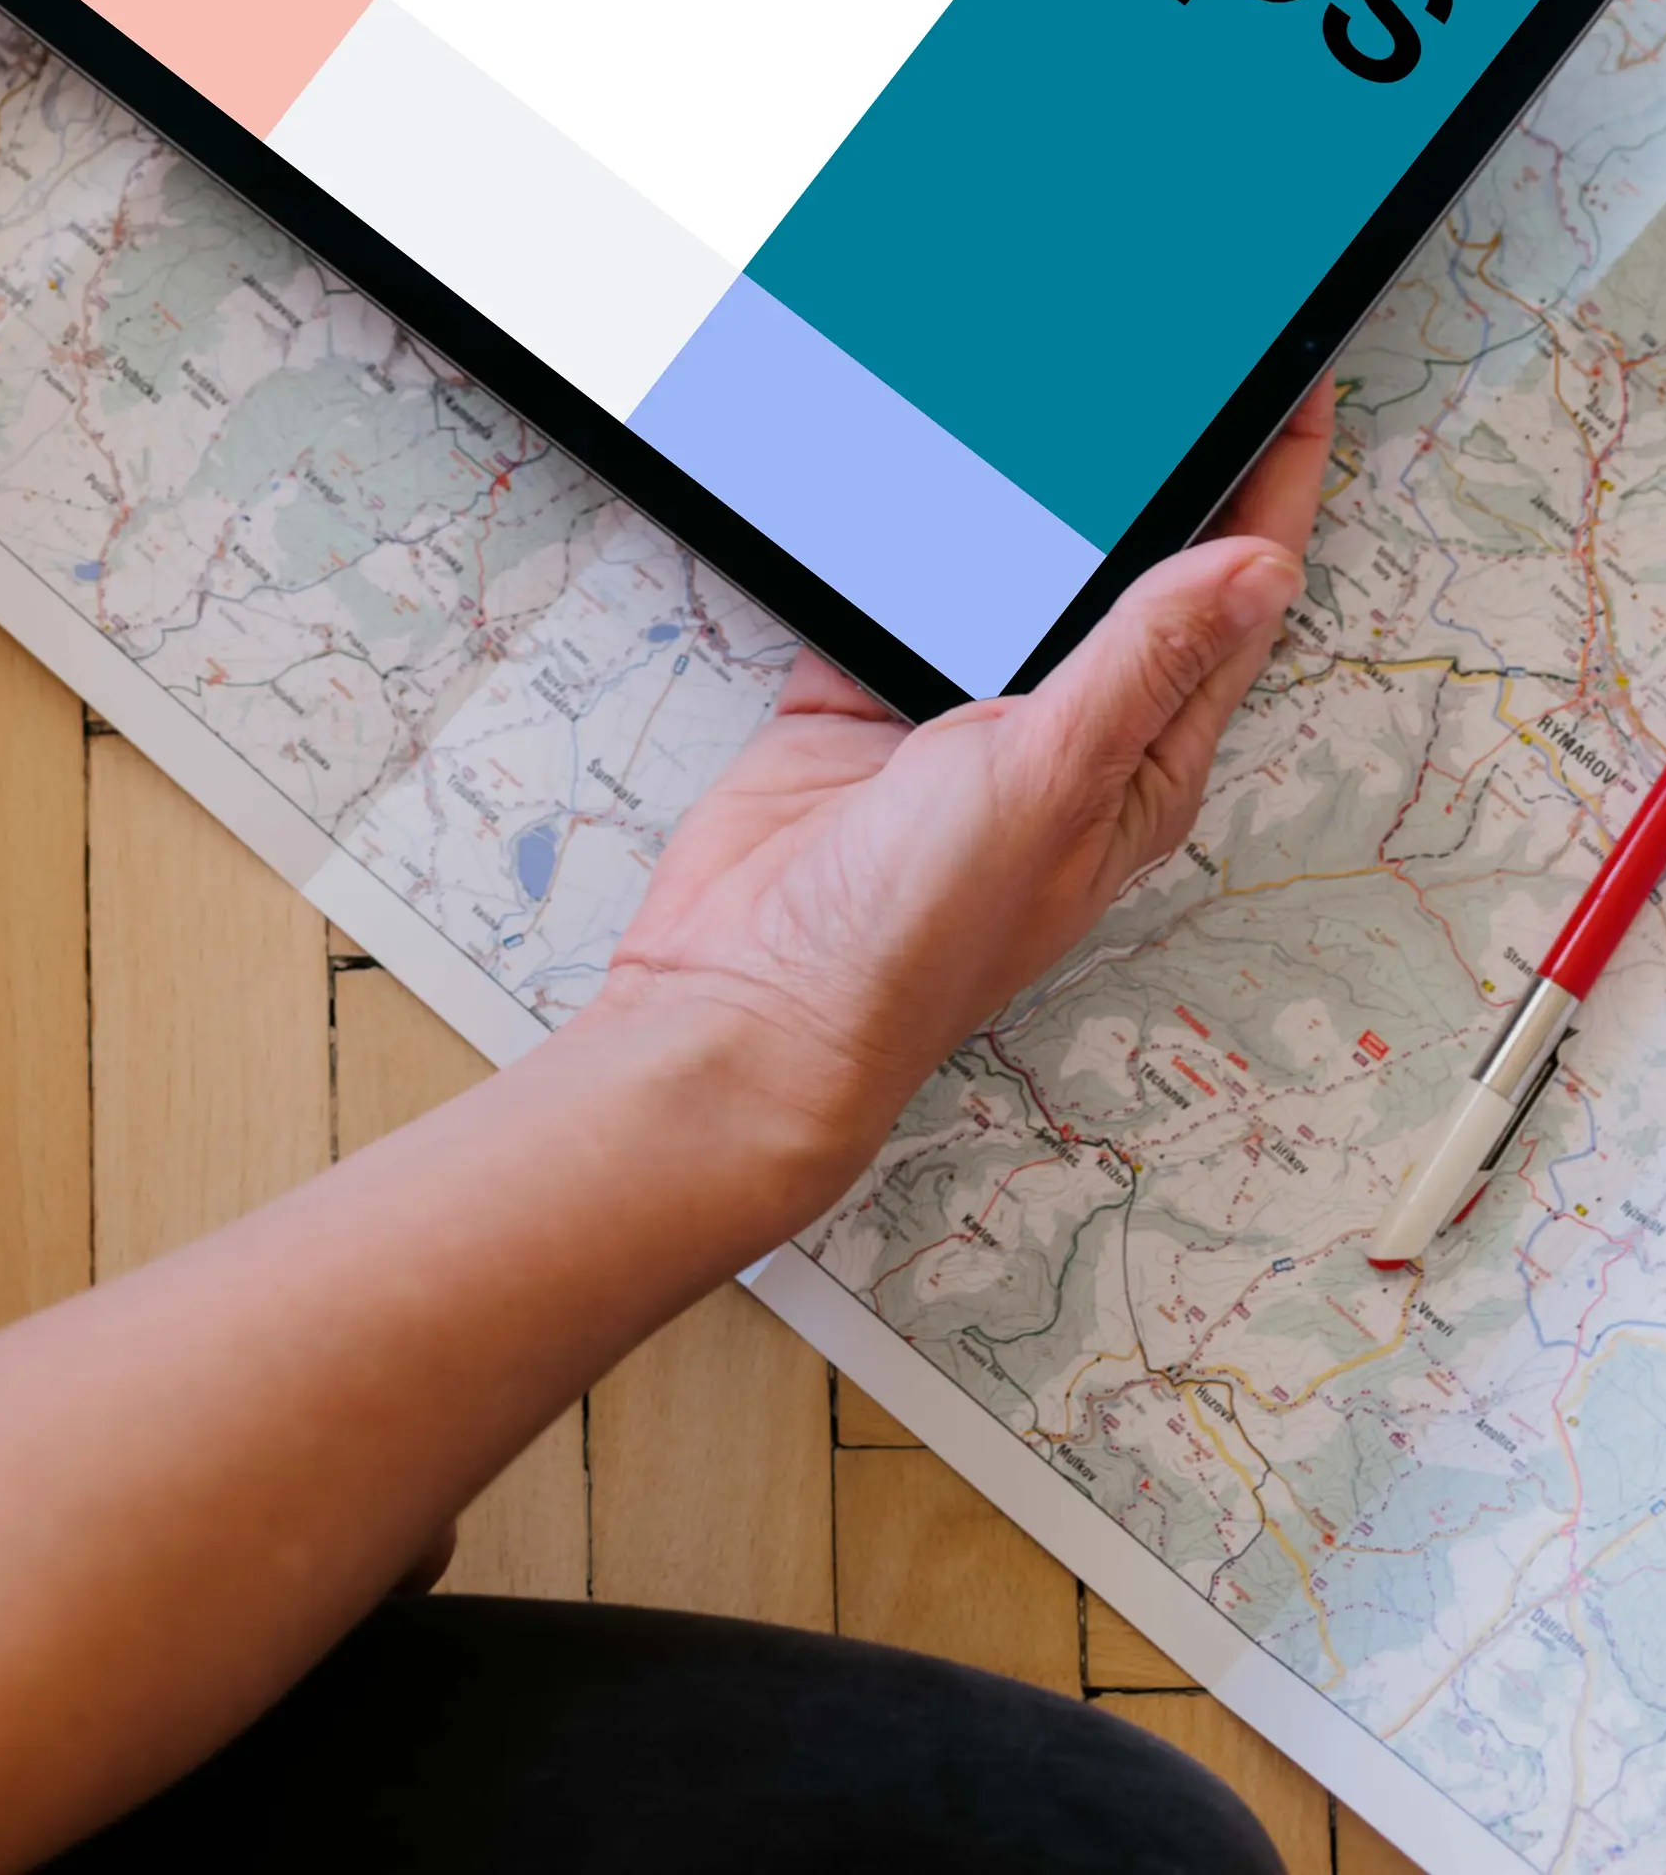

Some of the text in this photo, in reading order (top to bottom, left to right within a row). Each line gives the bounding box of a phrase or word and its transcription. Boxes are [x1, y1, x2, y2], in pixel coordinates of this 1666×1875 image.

[1504, 947, 1536, 978] Strán
[1133, 1059, 1197, 1113] Těchanov
[957, 1209, 1005, 1252] Karlov
[1051, 1440, 1103, 1485] Mutkov
